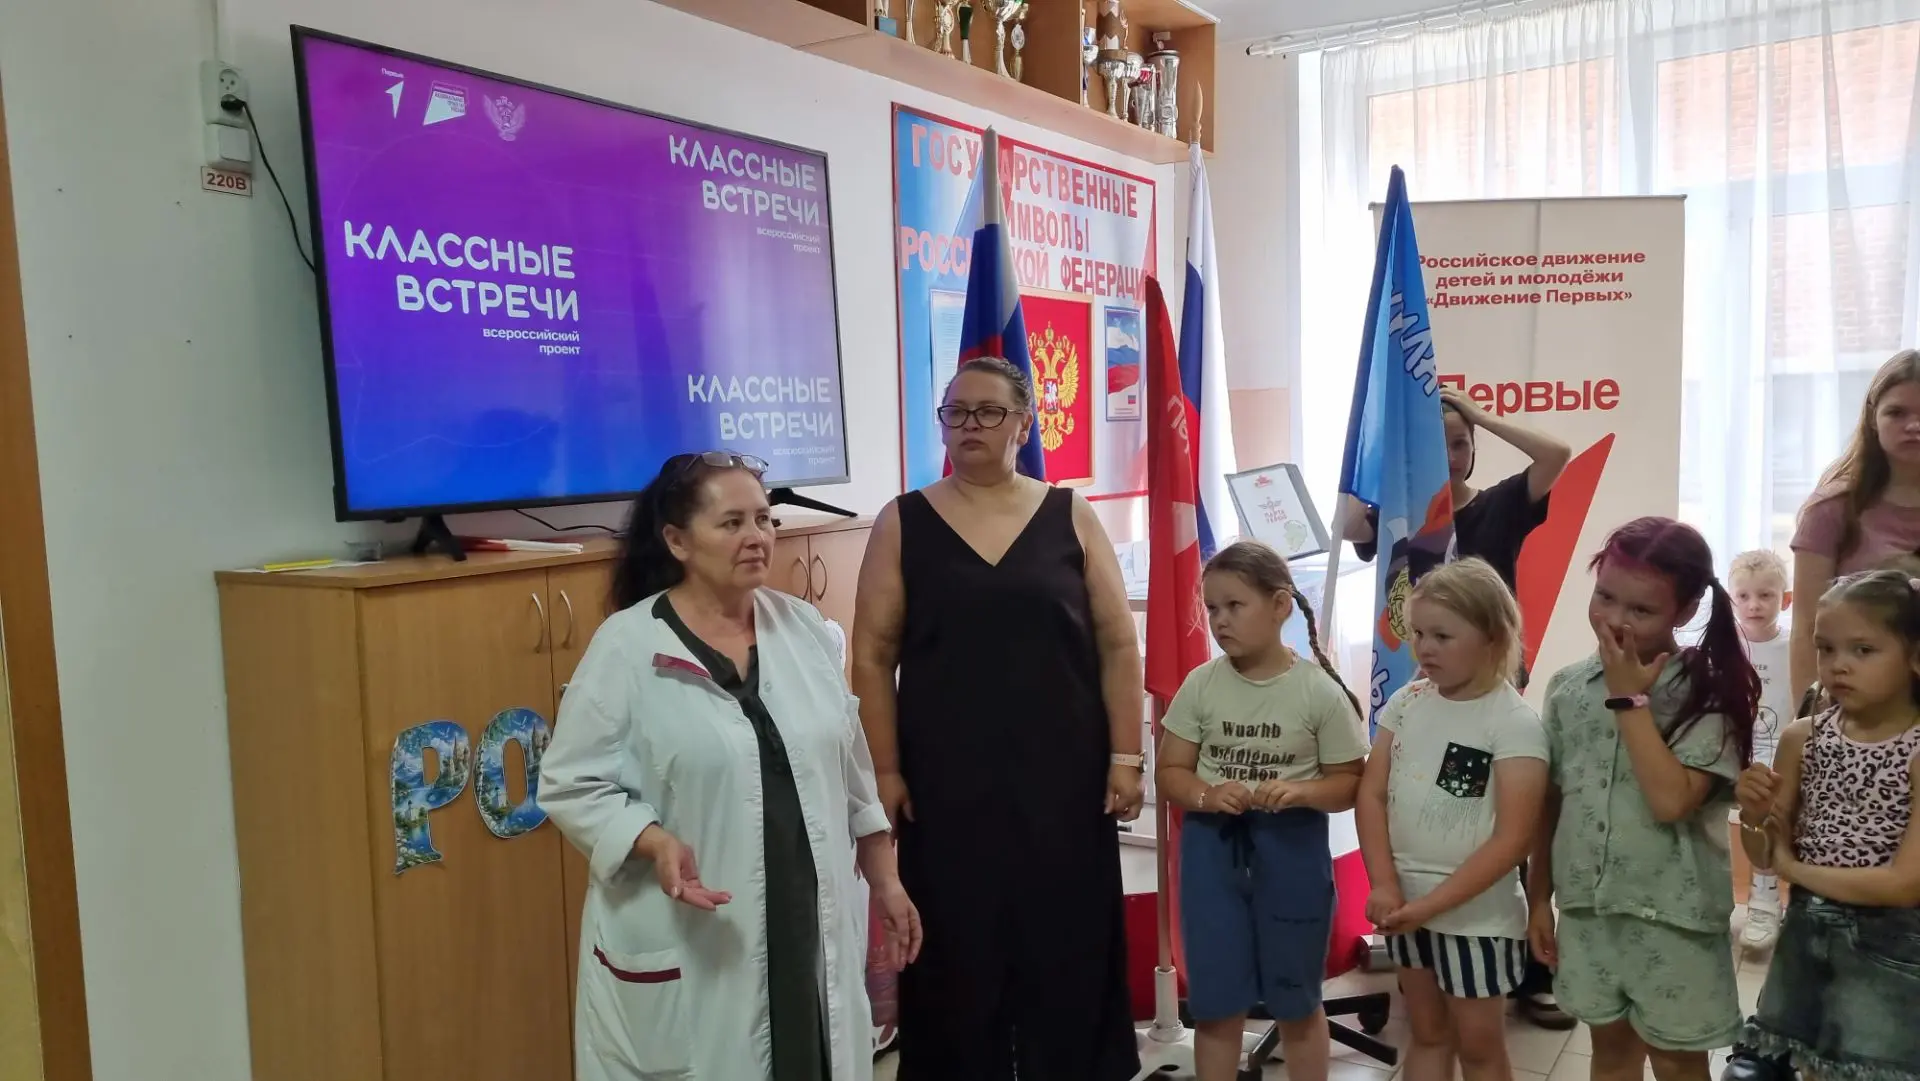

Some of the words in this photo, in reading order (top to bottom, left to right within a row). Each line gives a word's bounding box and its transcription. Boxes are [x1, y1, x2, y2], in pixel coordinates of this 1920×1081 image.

[669, 134, 817, 192] КЛАССНЫЕ
[911, 123, 1138, 218] ГОСУАРСТВЕННЫЕ
[702, 179, 820, 226] ВСТРЕЧИ
[1007, 200, 1090, 253] ИМВОЛЫ
[344, 220, 576, 279] КЛАССНЫЕ
[1541, 252, 1646, 267] движение
[1060, 254, 1146, 300] ФЕДЕРАЦИ
[1435, 272, 1496, 289] детей
[1501, 275, 1513, 286] и
[1518, 269, 1625, 286] молодёжи
[396, 274, 579, 322] ВСТРЕЧИ
[1427, 292, 1542, 308] «Движение
[1546, 289, 1633, 305] Первых»
[482, 328, 580, 343] всероссийский
[539, 344, 580, 356] проект
[687, 374, 833, 403] КЛАССНЫЕ
[719, 411, 835, 441] ВСТРЕЧИ
